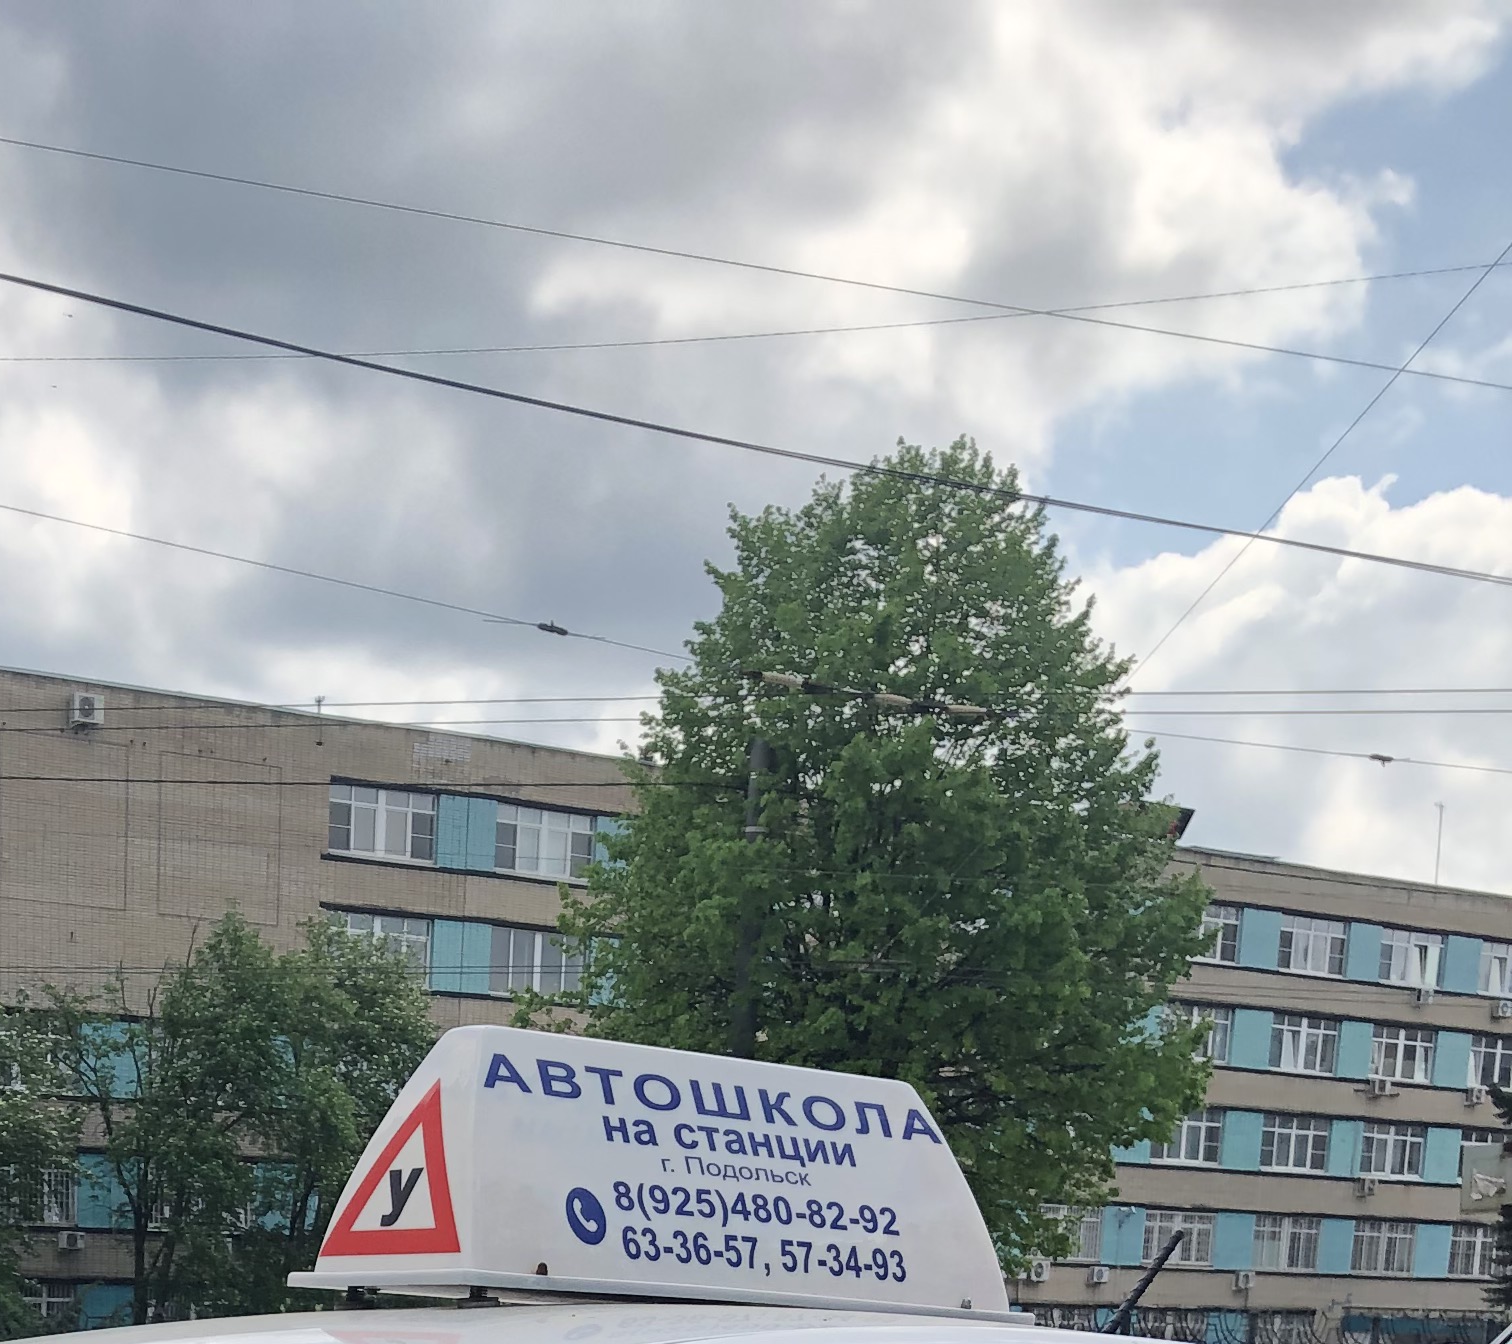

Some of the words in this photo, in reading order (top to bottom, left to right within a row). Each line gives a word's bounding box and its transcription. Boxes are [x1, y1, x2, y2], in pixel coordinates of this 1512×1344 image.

[483, 1053, 942, 1145] АВТОШКОЛА
[604, 1116, 658, 1147] на
[674, 1122, 857, 1168] станции
[661, 1159, 675, 1175] г.
[685, 1157, 811, 1186] Подольск
[613, 1181, 901, 1237] 8(925)480-82-92
[622, 1227, 772, 1277] 63-36-57,
[780, 1240, 908, 1283] 57-34-93
